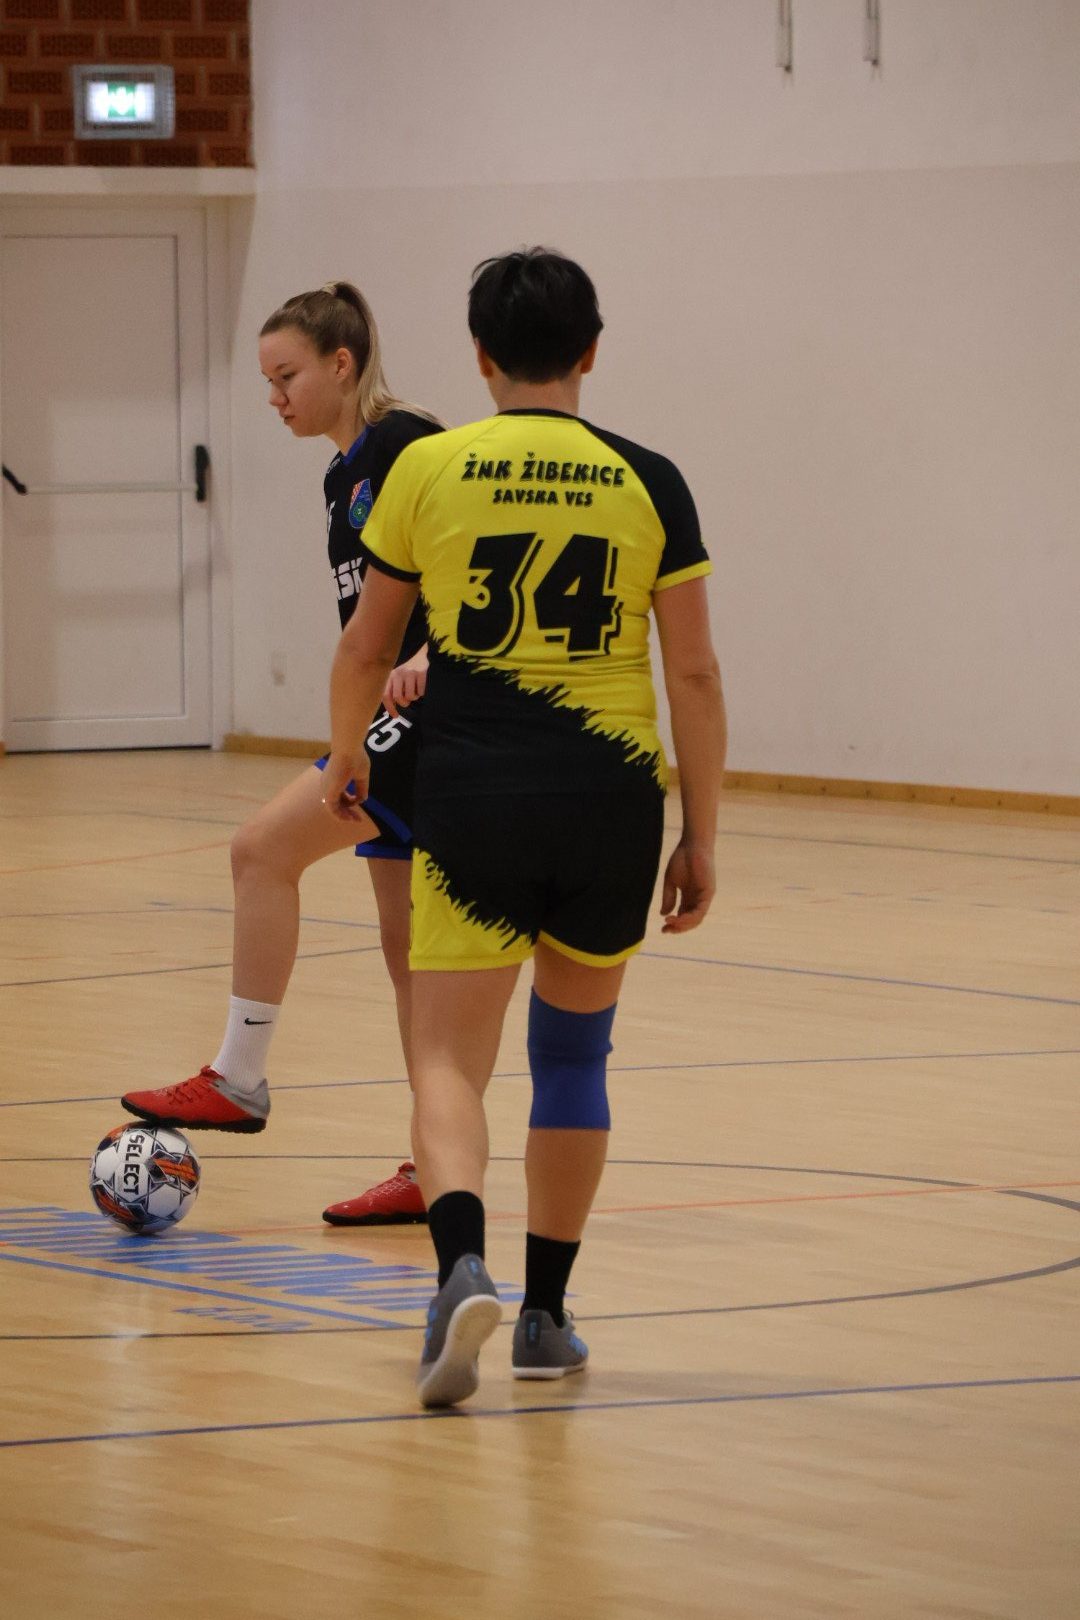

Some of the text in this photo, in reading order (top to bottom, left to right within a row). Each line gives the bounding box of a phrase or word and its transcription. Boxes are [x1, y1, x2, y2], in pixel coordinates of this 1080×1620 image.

[461, 451, 626, 488] ŽNK ŽIBEKICE
[493, 488, 594, 508] SAVSKA VES
[456, 532, 624, 662] 34
[124, 1134, 145, 1195] SELECT
